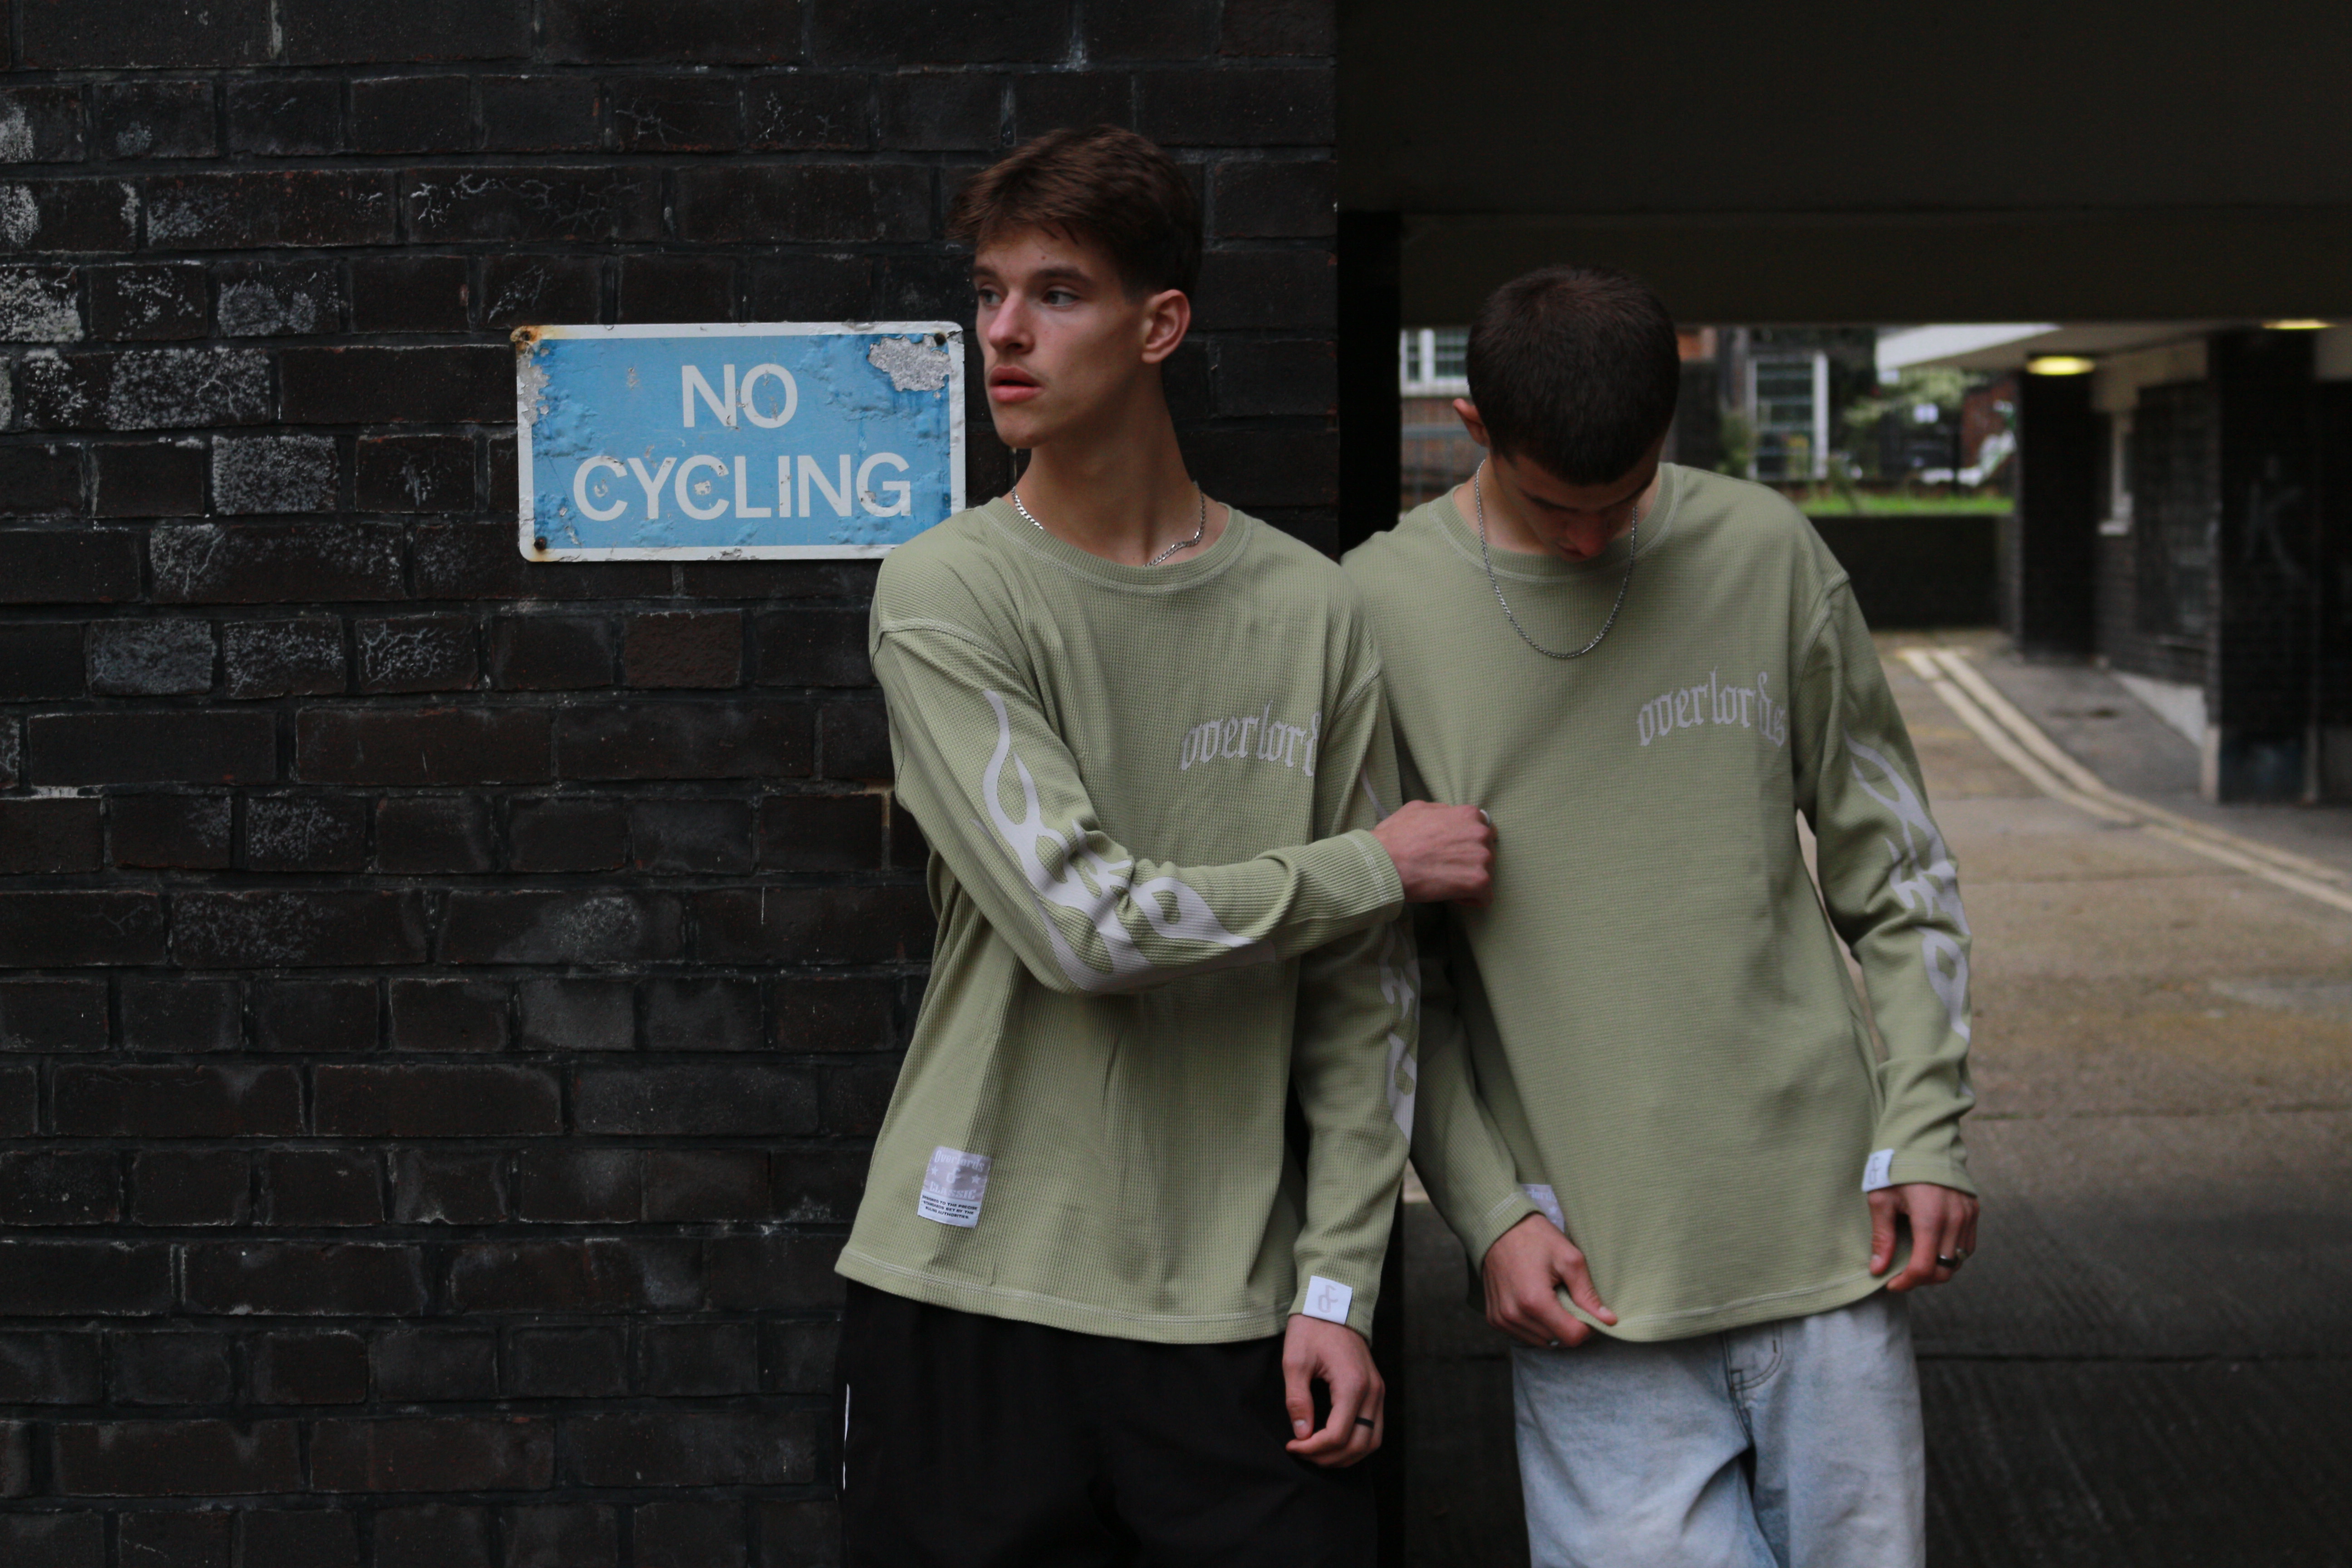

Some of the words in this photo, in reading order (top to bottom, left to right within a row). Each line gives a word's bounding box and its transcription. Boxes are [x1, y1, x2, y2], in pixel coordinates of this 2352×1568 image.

[681, 363, 798, 429] NO
[572, 452, 911, 521] CYCLING
[930, 1181, 977, 1200] CLASSIC
